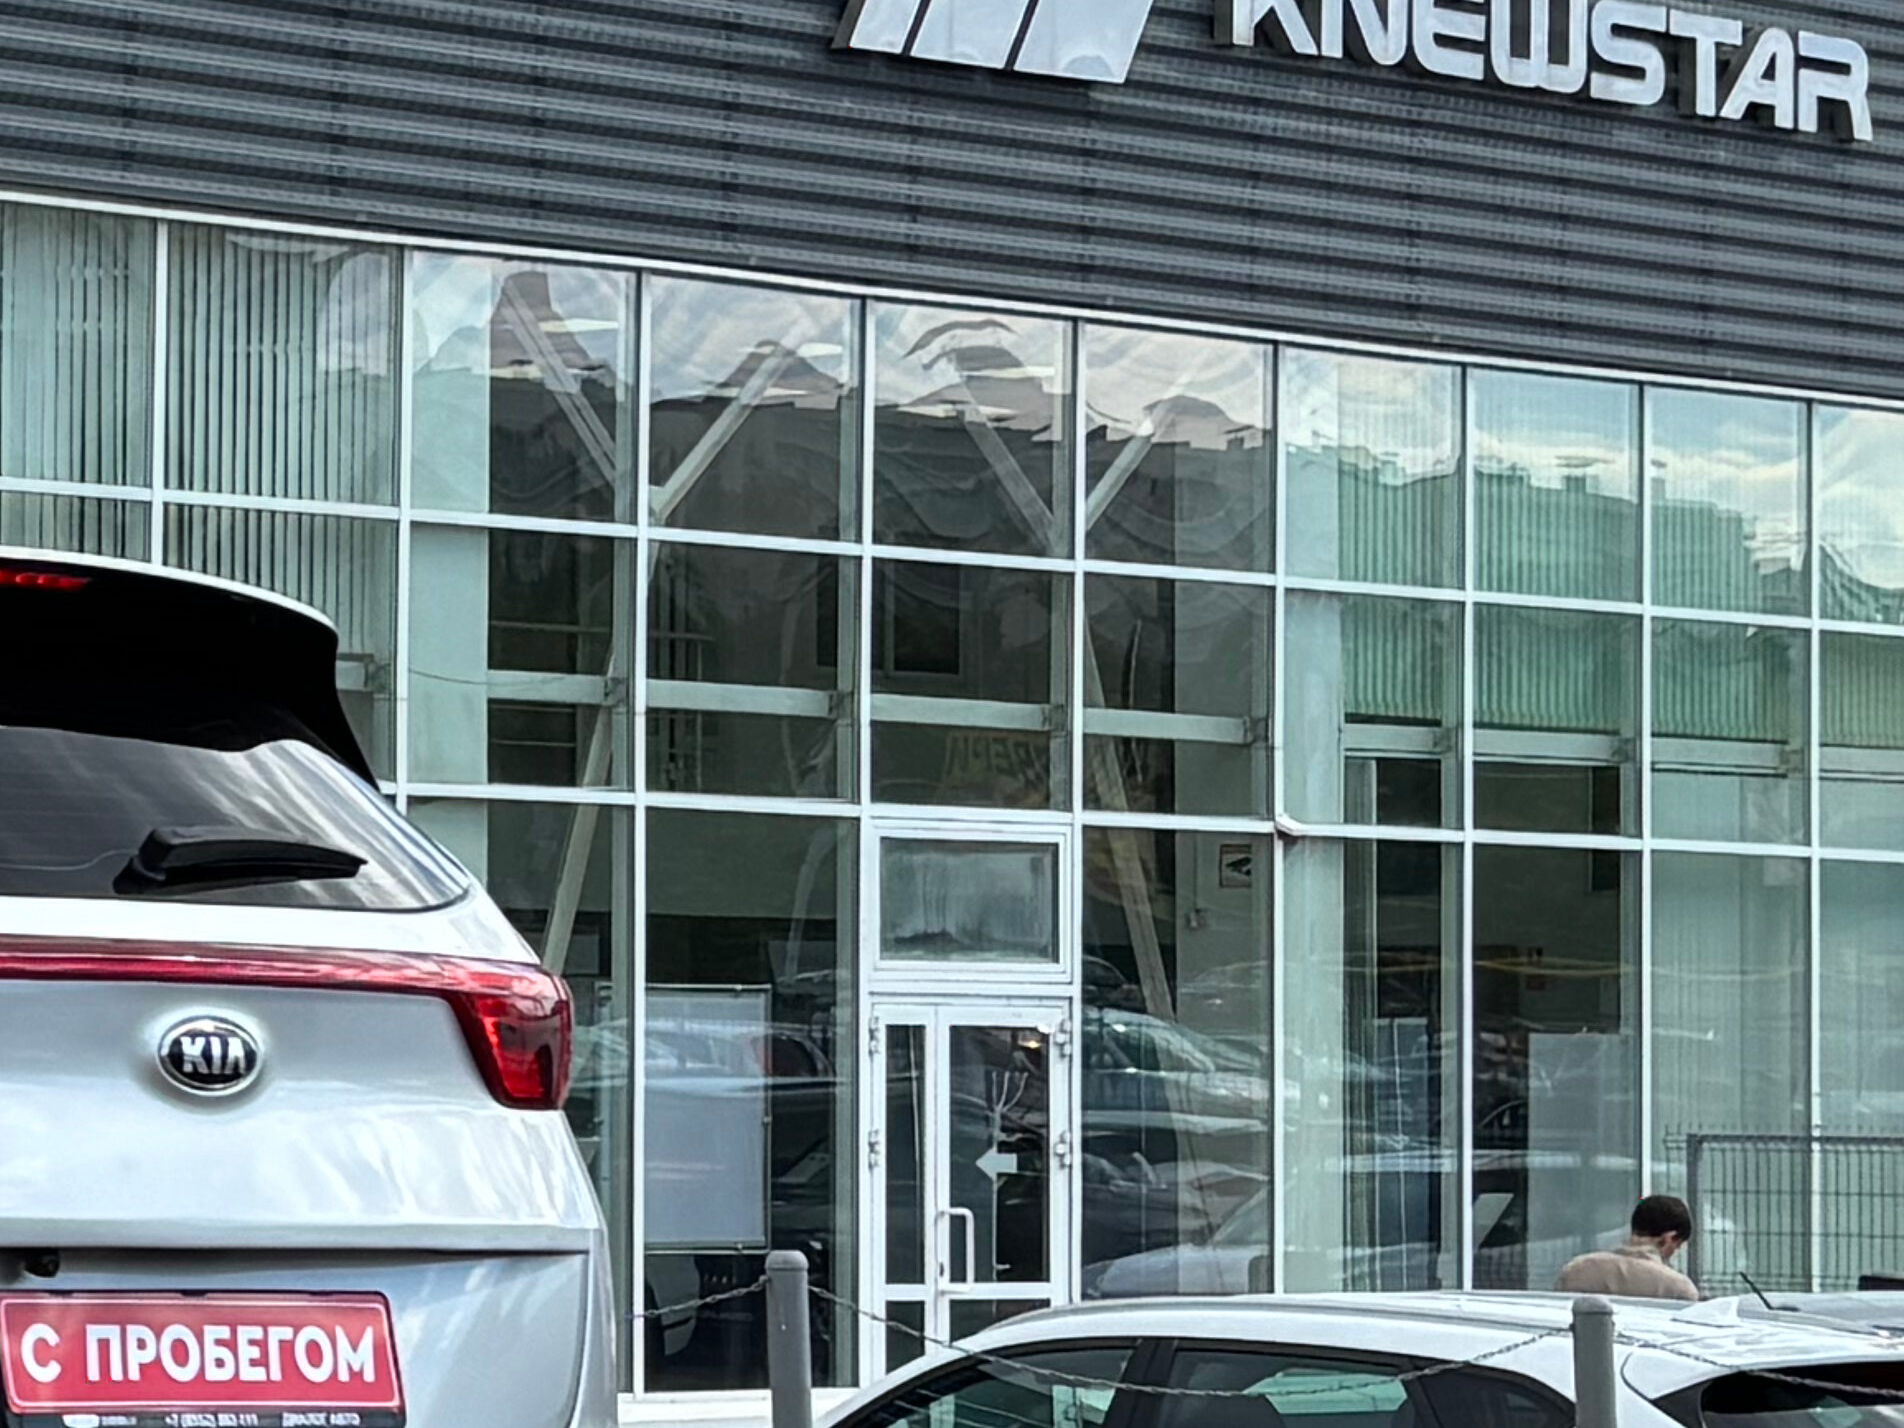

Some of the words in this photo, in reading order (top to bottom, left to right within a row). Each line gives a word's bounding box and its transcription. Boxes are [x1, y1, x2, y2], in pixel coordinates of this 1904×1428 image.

[180, 1036, 246, 1075] KIA
[20, 1322, 62, 1383] С
[86, 1322, 376, 1383] ПРОБЕГОМ
